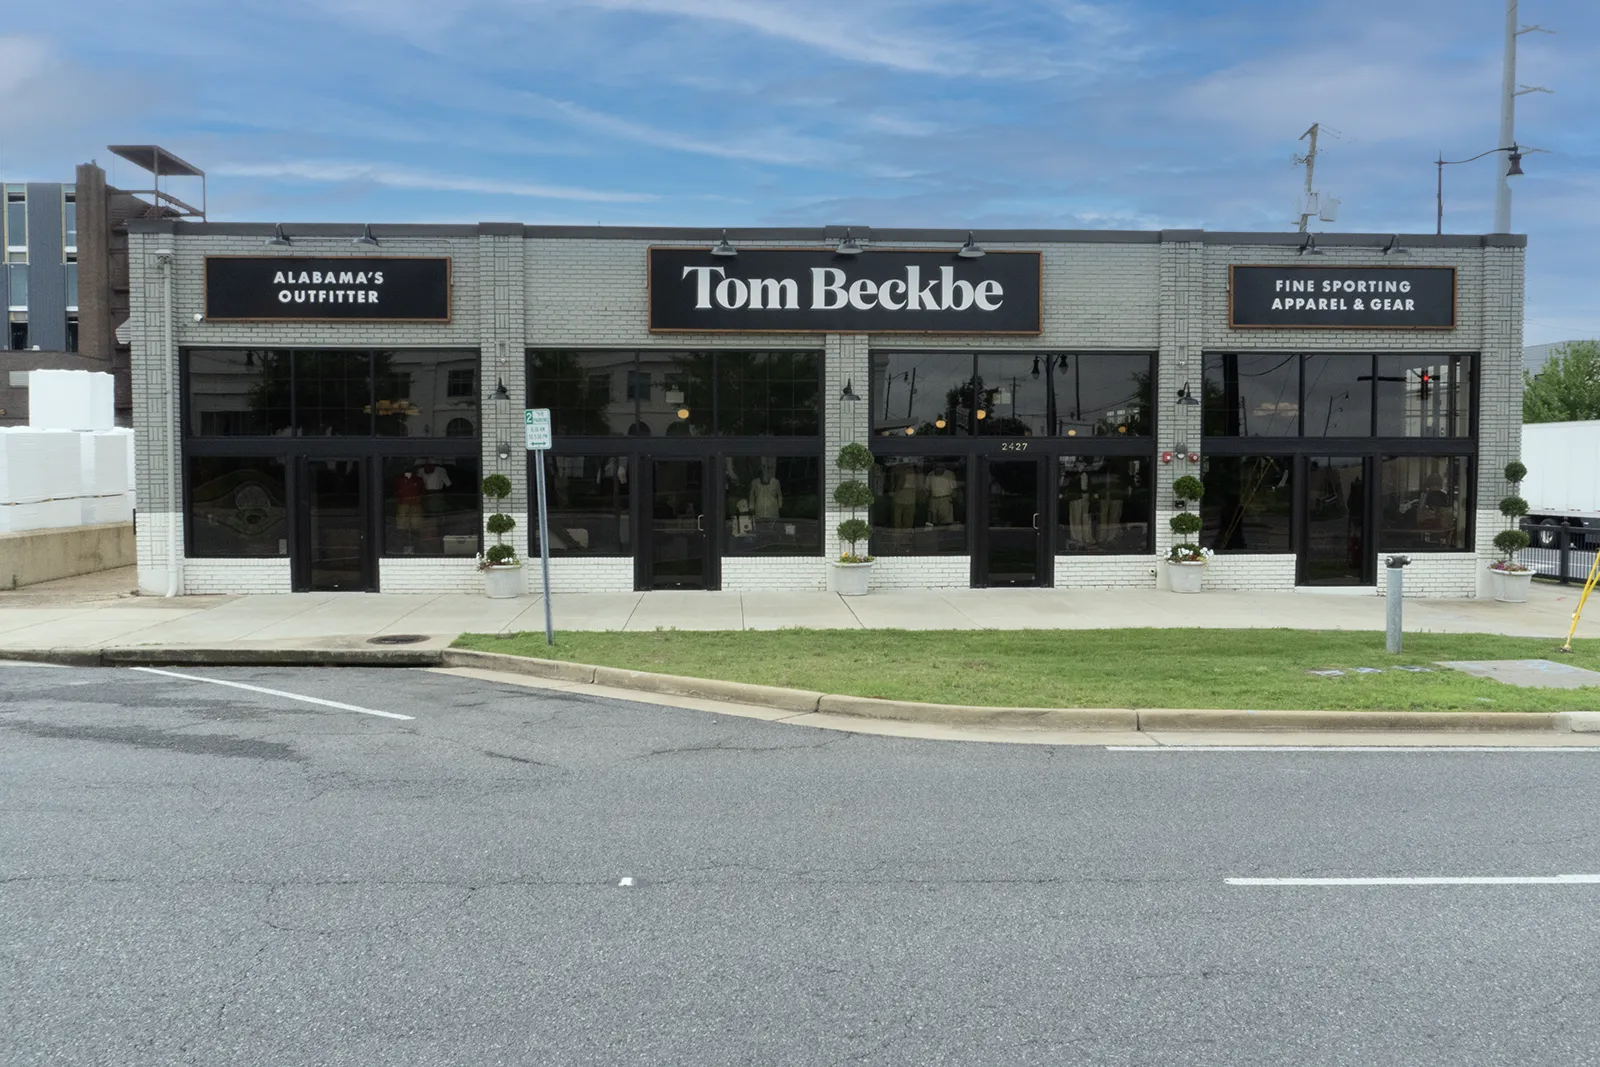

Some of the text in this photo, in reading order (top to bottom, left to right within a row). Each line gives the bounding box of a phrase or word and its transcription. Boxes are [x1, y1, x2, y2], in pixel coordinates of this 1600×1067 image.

[273, 271, 384, 284] ALABAMA'S
[682, 265, 1004, 312] Tom Beckbe
[1275, 279, 1412, 293] FINE SPORTING
[278, 289, 379, 303] OUTFITTER
[1271, 297, 1415, 311] APPAREL & GEAR
[526, 412, 532, 423] 2
[1001, 442, 1028, 451] 2427
